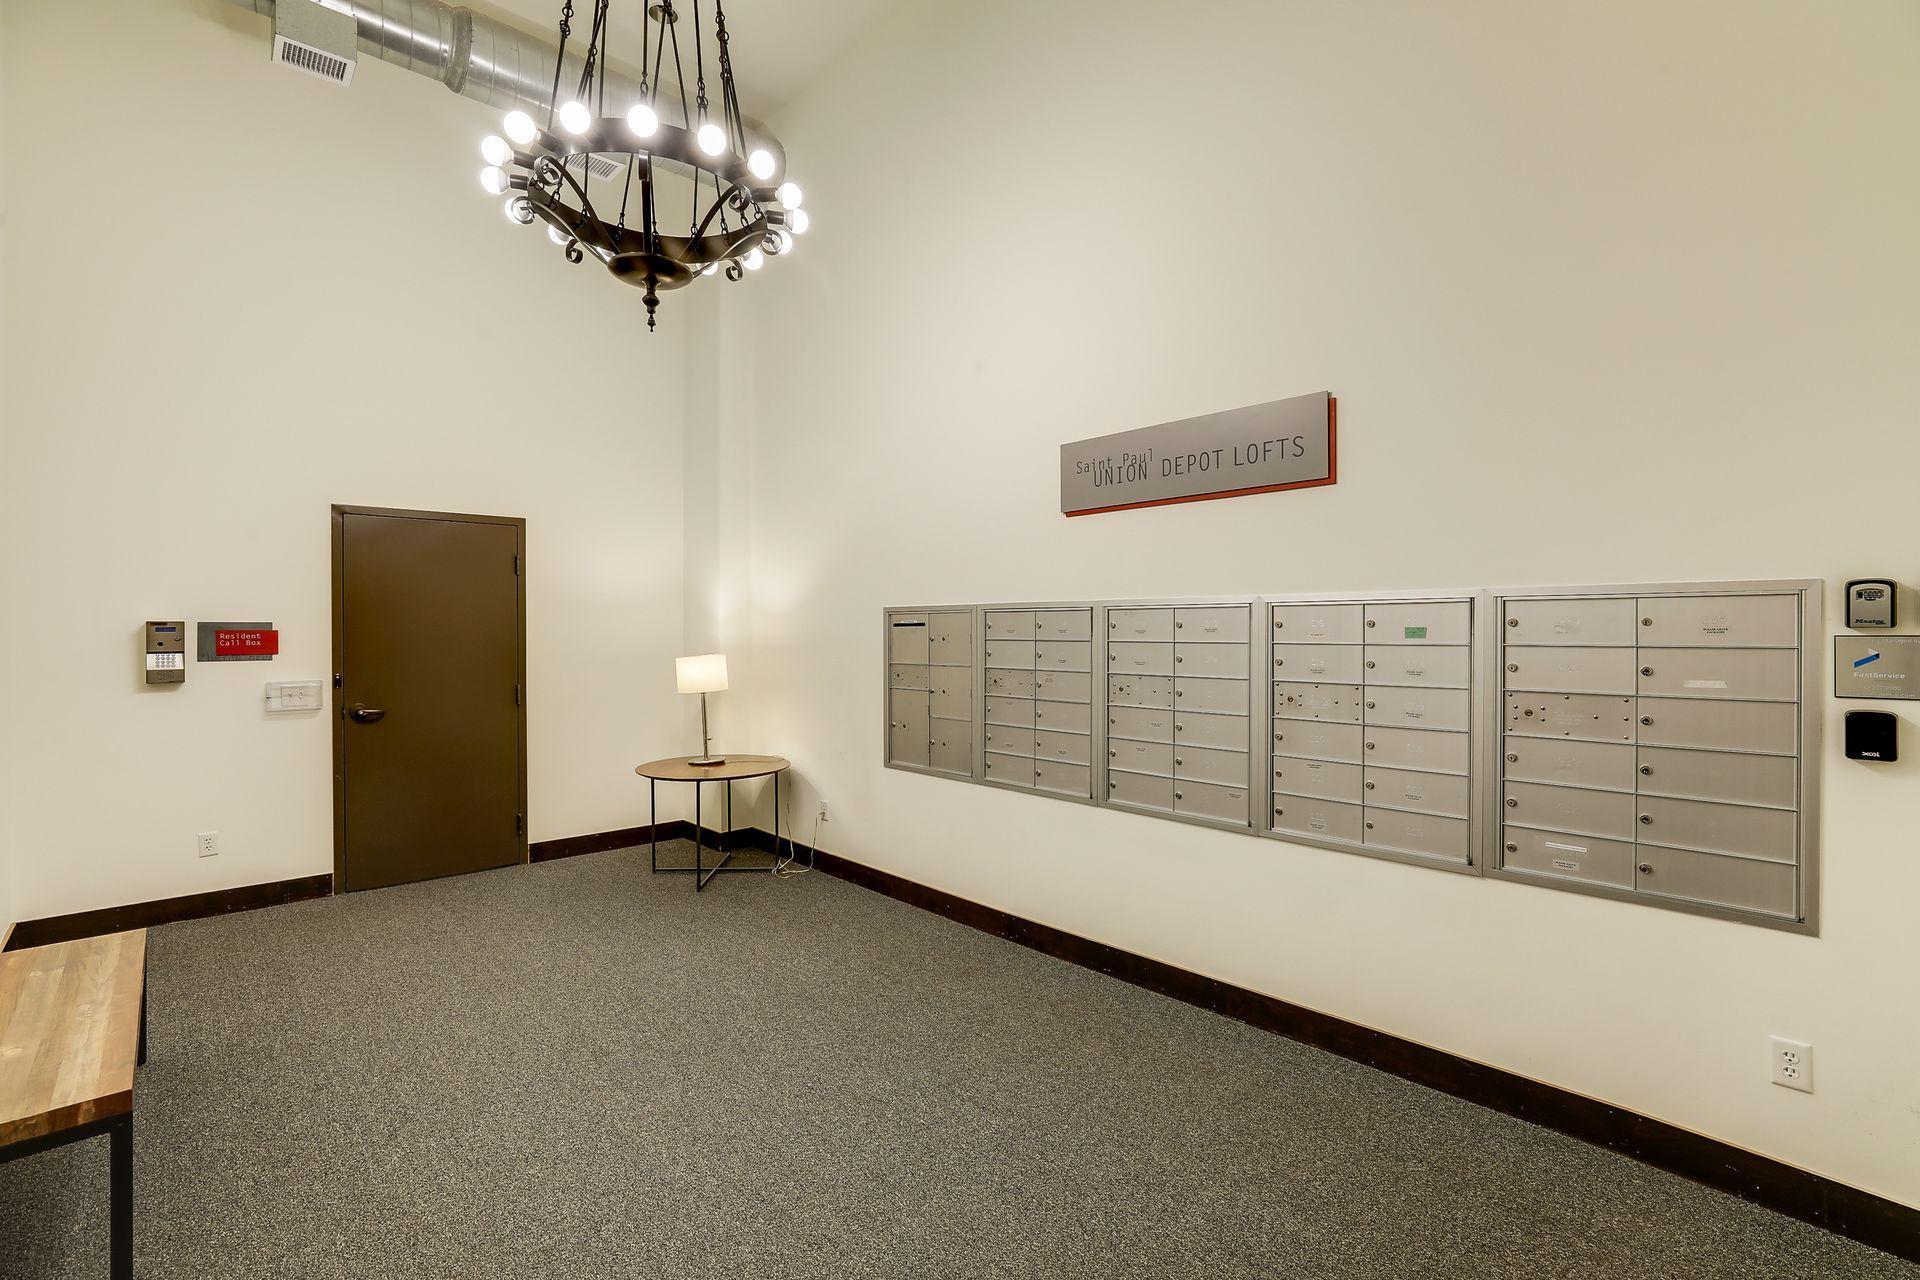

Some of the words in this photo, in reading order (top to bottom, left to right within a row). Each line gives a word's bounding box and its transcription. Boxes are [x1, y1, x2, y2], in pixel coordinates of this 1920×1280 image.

[1076, 457, 1113, 474] Saint
[1122, 448, 1153, 466] Paul
[1094, 461, 1147, 487] UNION
[1162, 449, 1224, 477] DEPOT
[1234, 436, 1305, 467] LOFTS
